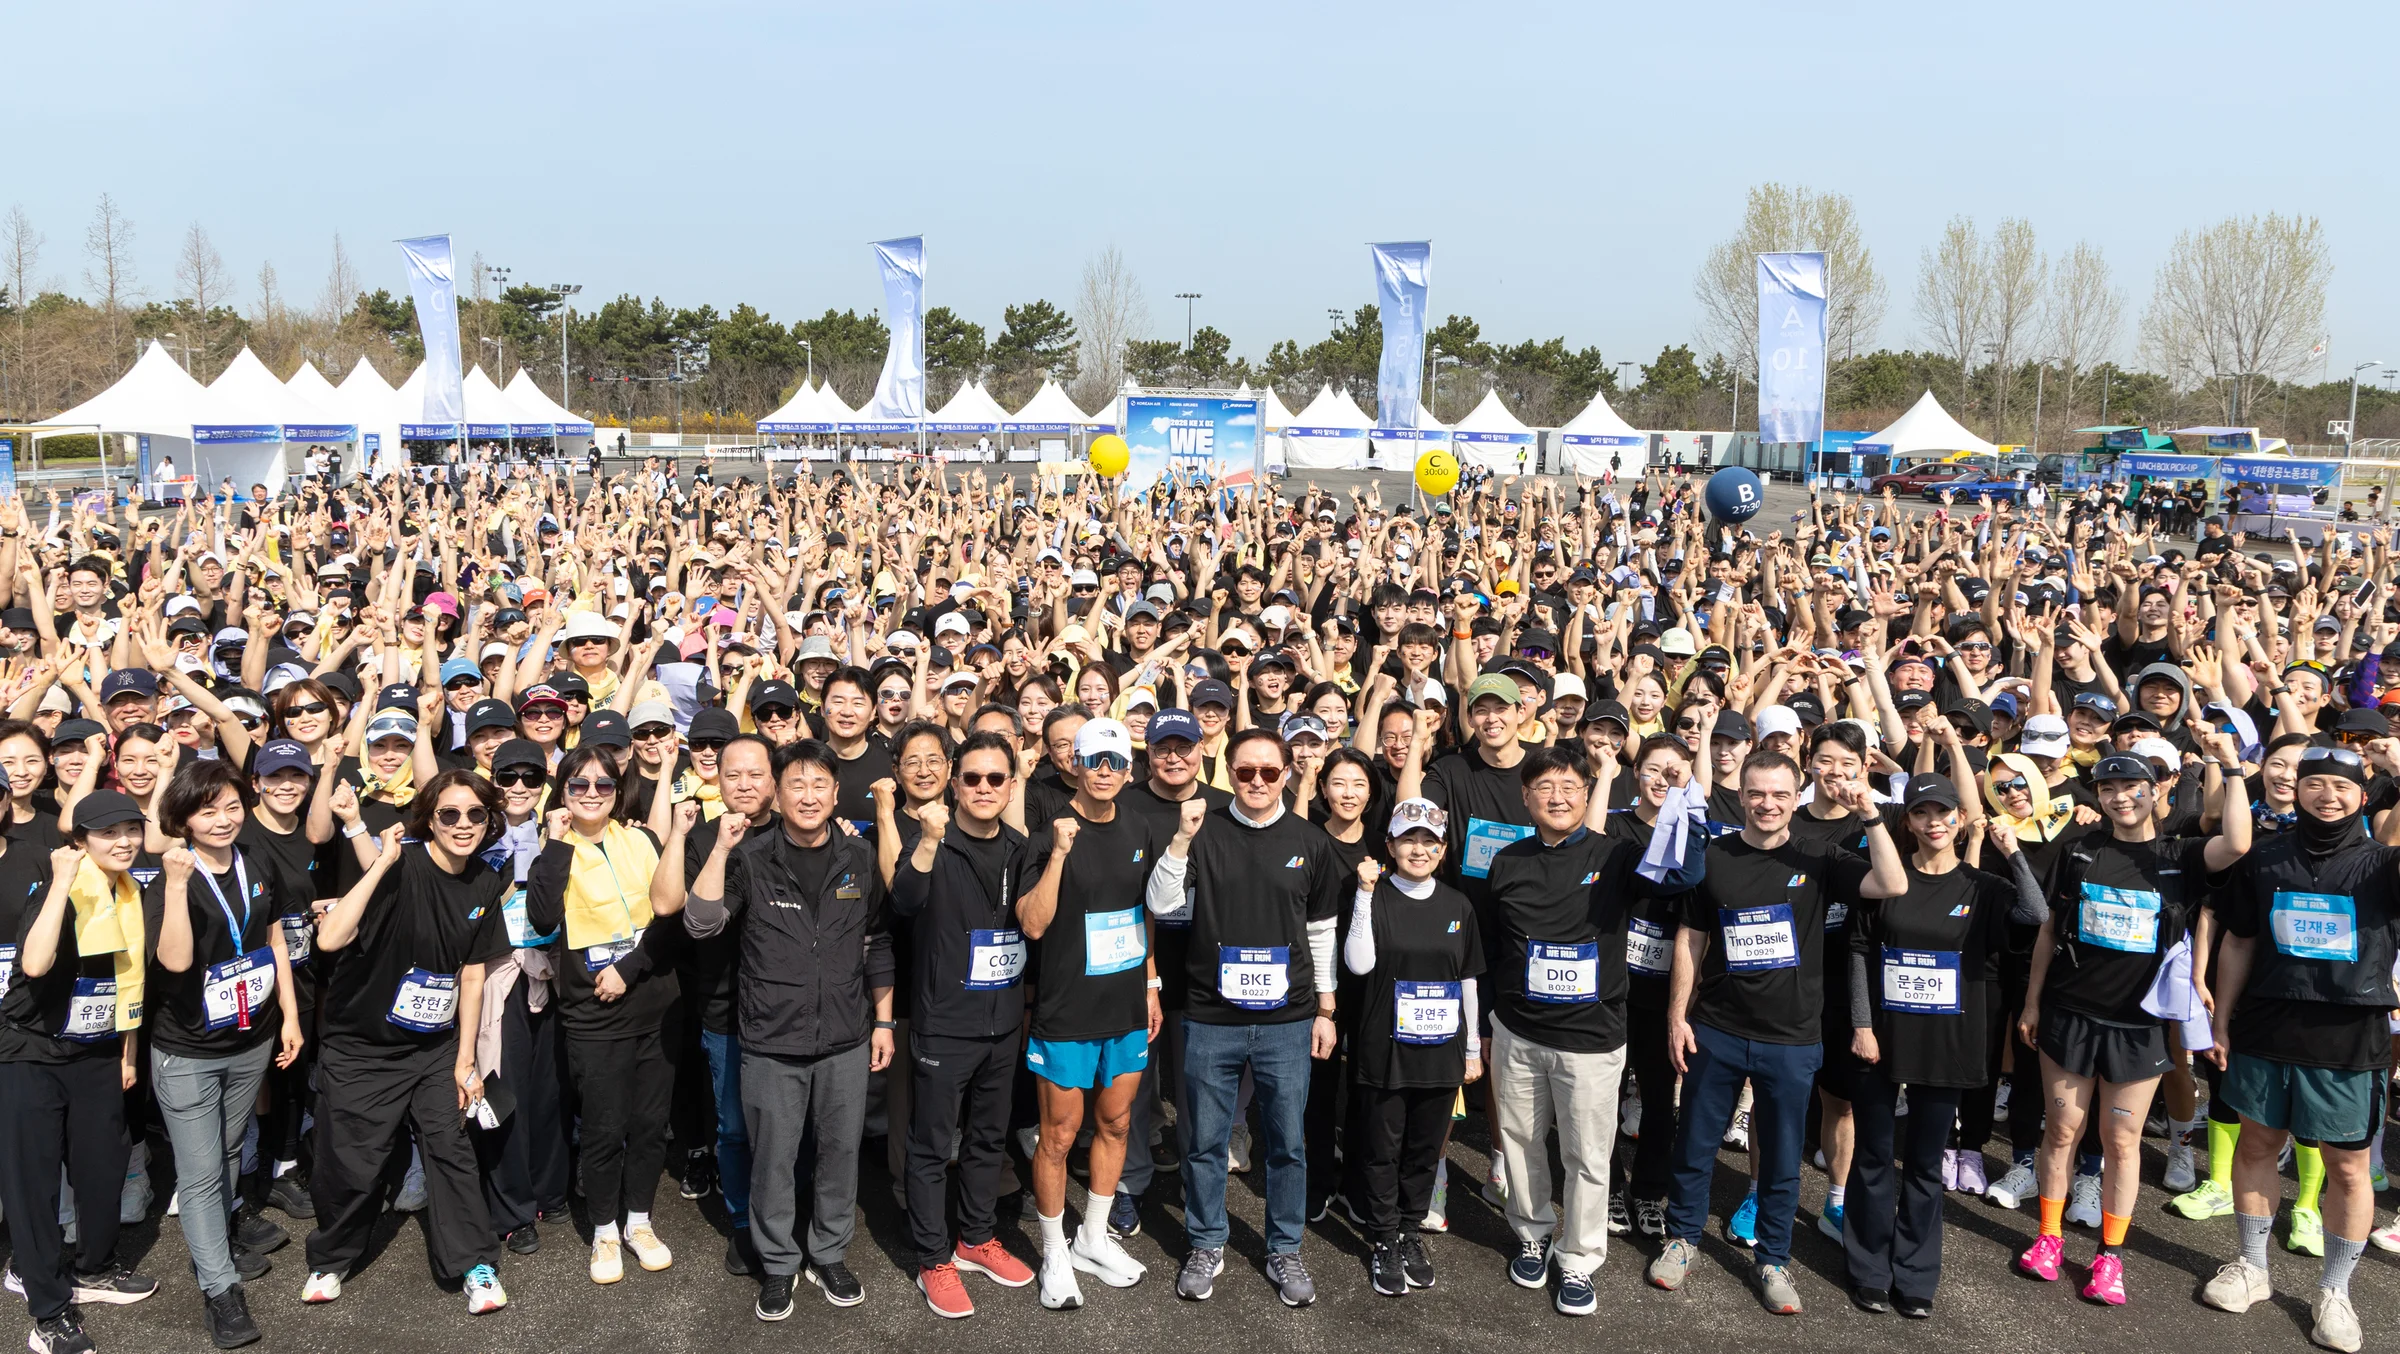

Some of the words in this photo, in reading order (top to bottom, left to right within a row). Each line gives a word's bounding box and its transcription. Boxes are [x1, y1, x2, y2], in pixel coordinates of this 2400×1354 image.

[1170, 428, 1213, 454] WE
[1170, 456, 1213, 475] RUN
[1430, 455, 1441, 467] C
[2136, 462, 2156, 470] LUNCH
[2157, 463, 2170, 471] BOX
[2171, 463, 2198, 472] PICK-UP
[2252, 466, 2319, 480] 대한항공노동조합
[1738, 484, 1754, 502] B
[1732, 500, 1760, 514] 27:30
[117, 672, 134, 685] NY
[605, 694, 615, 705] RU
[1156, 714, 1190, 729] SRIXON
[1488, 828, 1502, 837] WE
[1502, 830, 1516, 838] RUN
[2292, 900, 2308, 908] WE
[2309, 900, 2329, 910] RUN
[1108, 919, 1119, 927] WE
[1120, 918, 1133, 926] RUN
[1739, 914, 1751, 924] WE
[1752, 911, 1770, 922] RUN
[1635, 924, 1646, 934] WE
[1647, 928, 1663, 937] RUN
[2293, 919, 2338, 936] 김재용
[993, 936, 1004, 944] WE
[1005, 934, 1018, 943] RUN
[1114, 936, 1125, 950] 션
[1729, 935, 1753, 947] Tino
[1756, 932, 1788, 945] Basile
[2303, 937, 2327, 945] 0213
[1240, 954, 1253, 962] WE
[1254, 954, 1271, 962] RUN
[1546, 949, 1559, 957] WE
[1560, 950, 1577, 958] RUN
[1754, 948, 1774, 957] 0929
[989, 953, 1018, 967] COZ
[1635, 956, 1654, 966] 0508
[1903, 957, 1916, 965] WE
[1918, 958, 1935, 966] RUN
[996, 969, 1013, 977] 0228
[1547, 969, 1578, 982] DIO
[1240, 974, 1272, 986] BKE
[1897, 974, 1943, 991] 문슬아
[94, 986, 107, 994] WE
[220, 976, 263, 1001] 이정
[1417, 989, 1428, 997] WE
[1913, 992, 1935, 1000] 0777
[230, 1003, 236, 1011] D
[411, 996, 452, 1010] 장현경
[422, 1012, 443, 1020] 0877
[1414, 1008, 1447, 1020] 길연주
